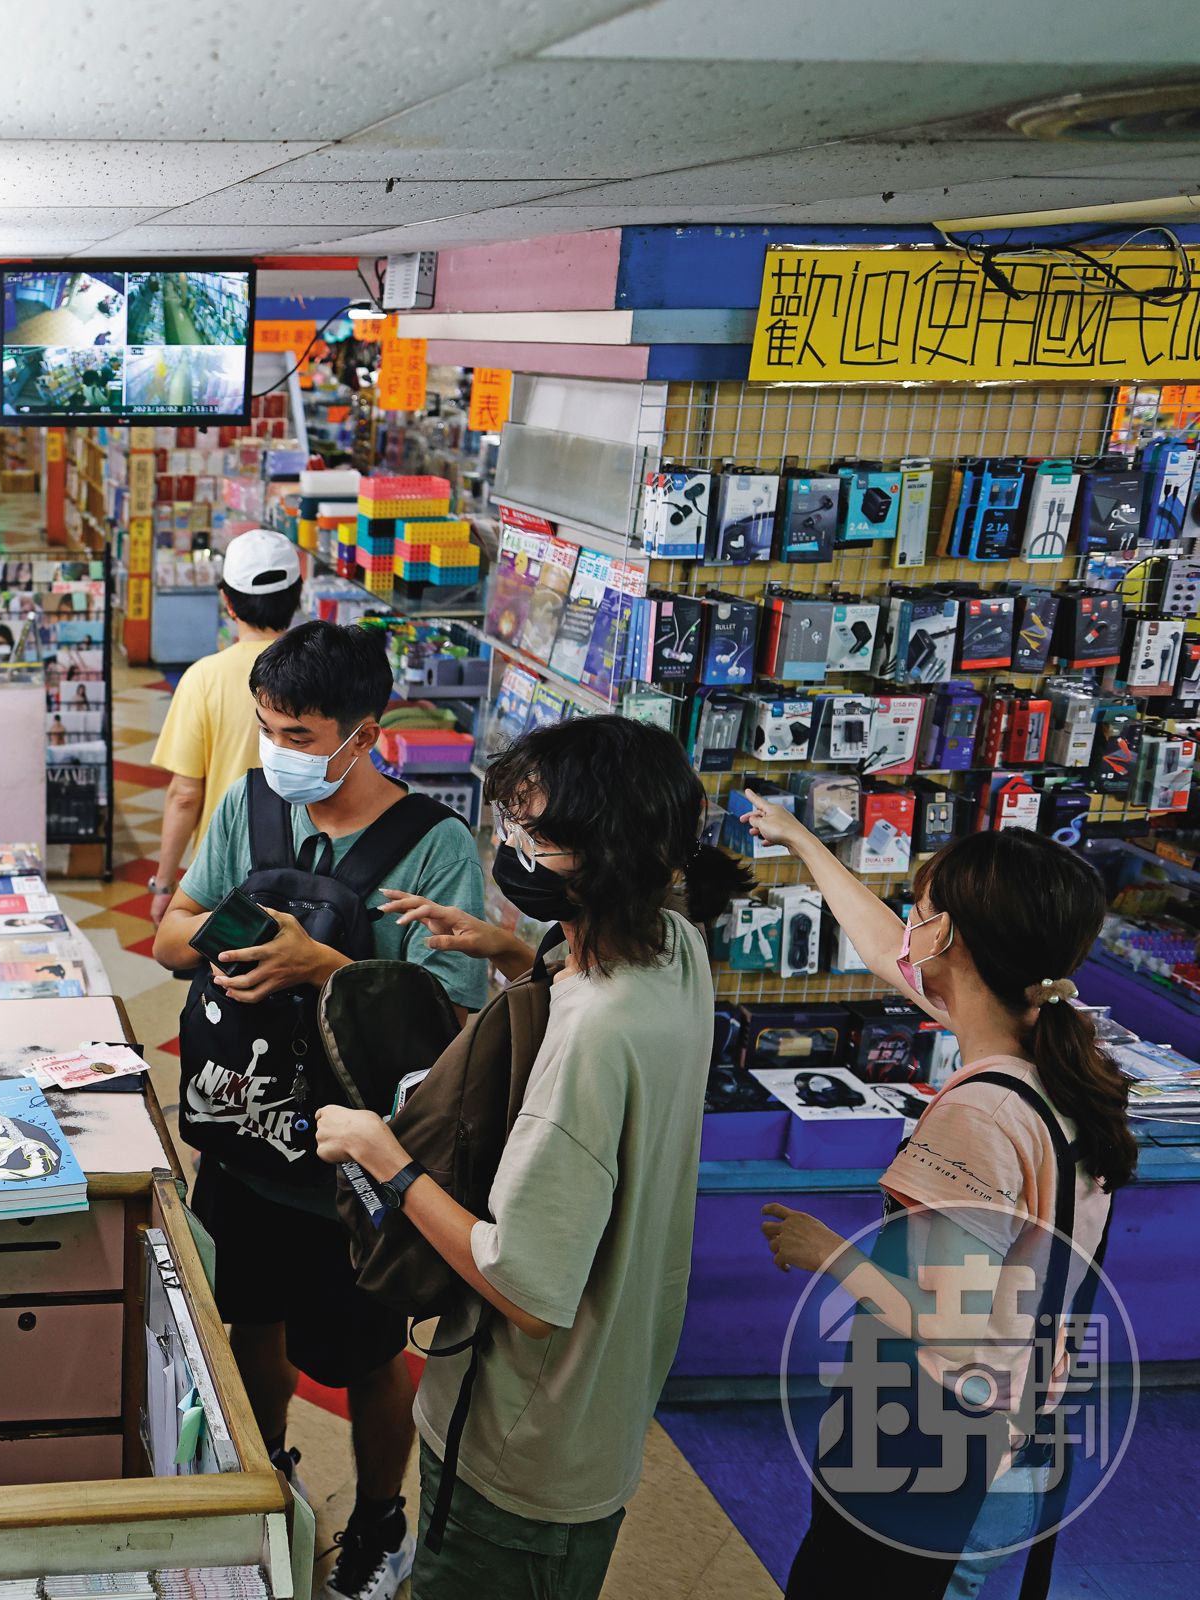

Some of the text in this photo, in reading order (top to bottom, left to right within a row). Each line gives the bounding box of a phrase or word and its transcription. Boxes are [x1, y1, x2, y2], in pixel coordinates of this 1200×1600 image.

[985, 522, 1010, 533] 2.1A
[714, 623, 737, 631] BULLET
[885, 1006, 913, 1014] REX
[878, 1040, 904, 1050] REX
[237, 1111, 296, 1142] AIR
[912, 1153, 958, 1181] FASHION
[965, 1183, 993, 1202] VICTIM
[351, 1177, 373, 1196] MUSIC
[360, 1190, 384, 1216] FESTIVAL
